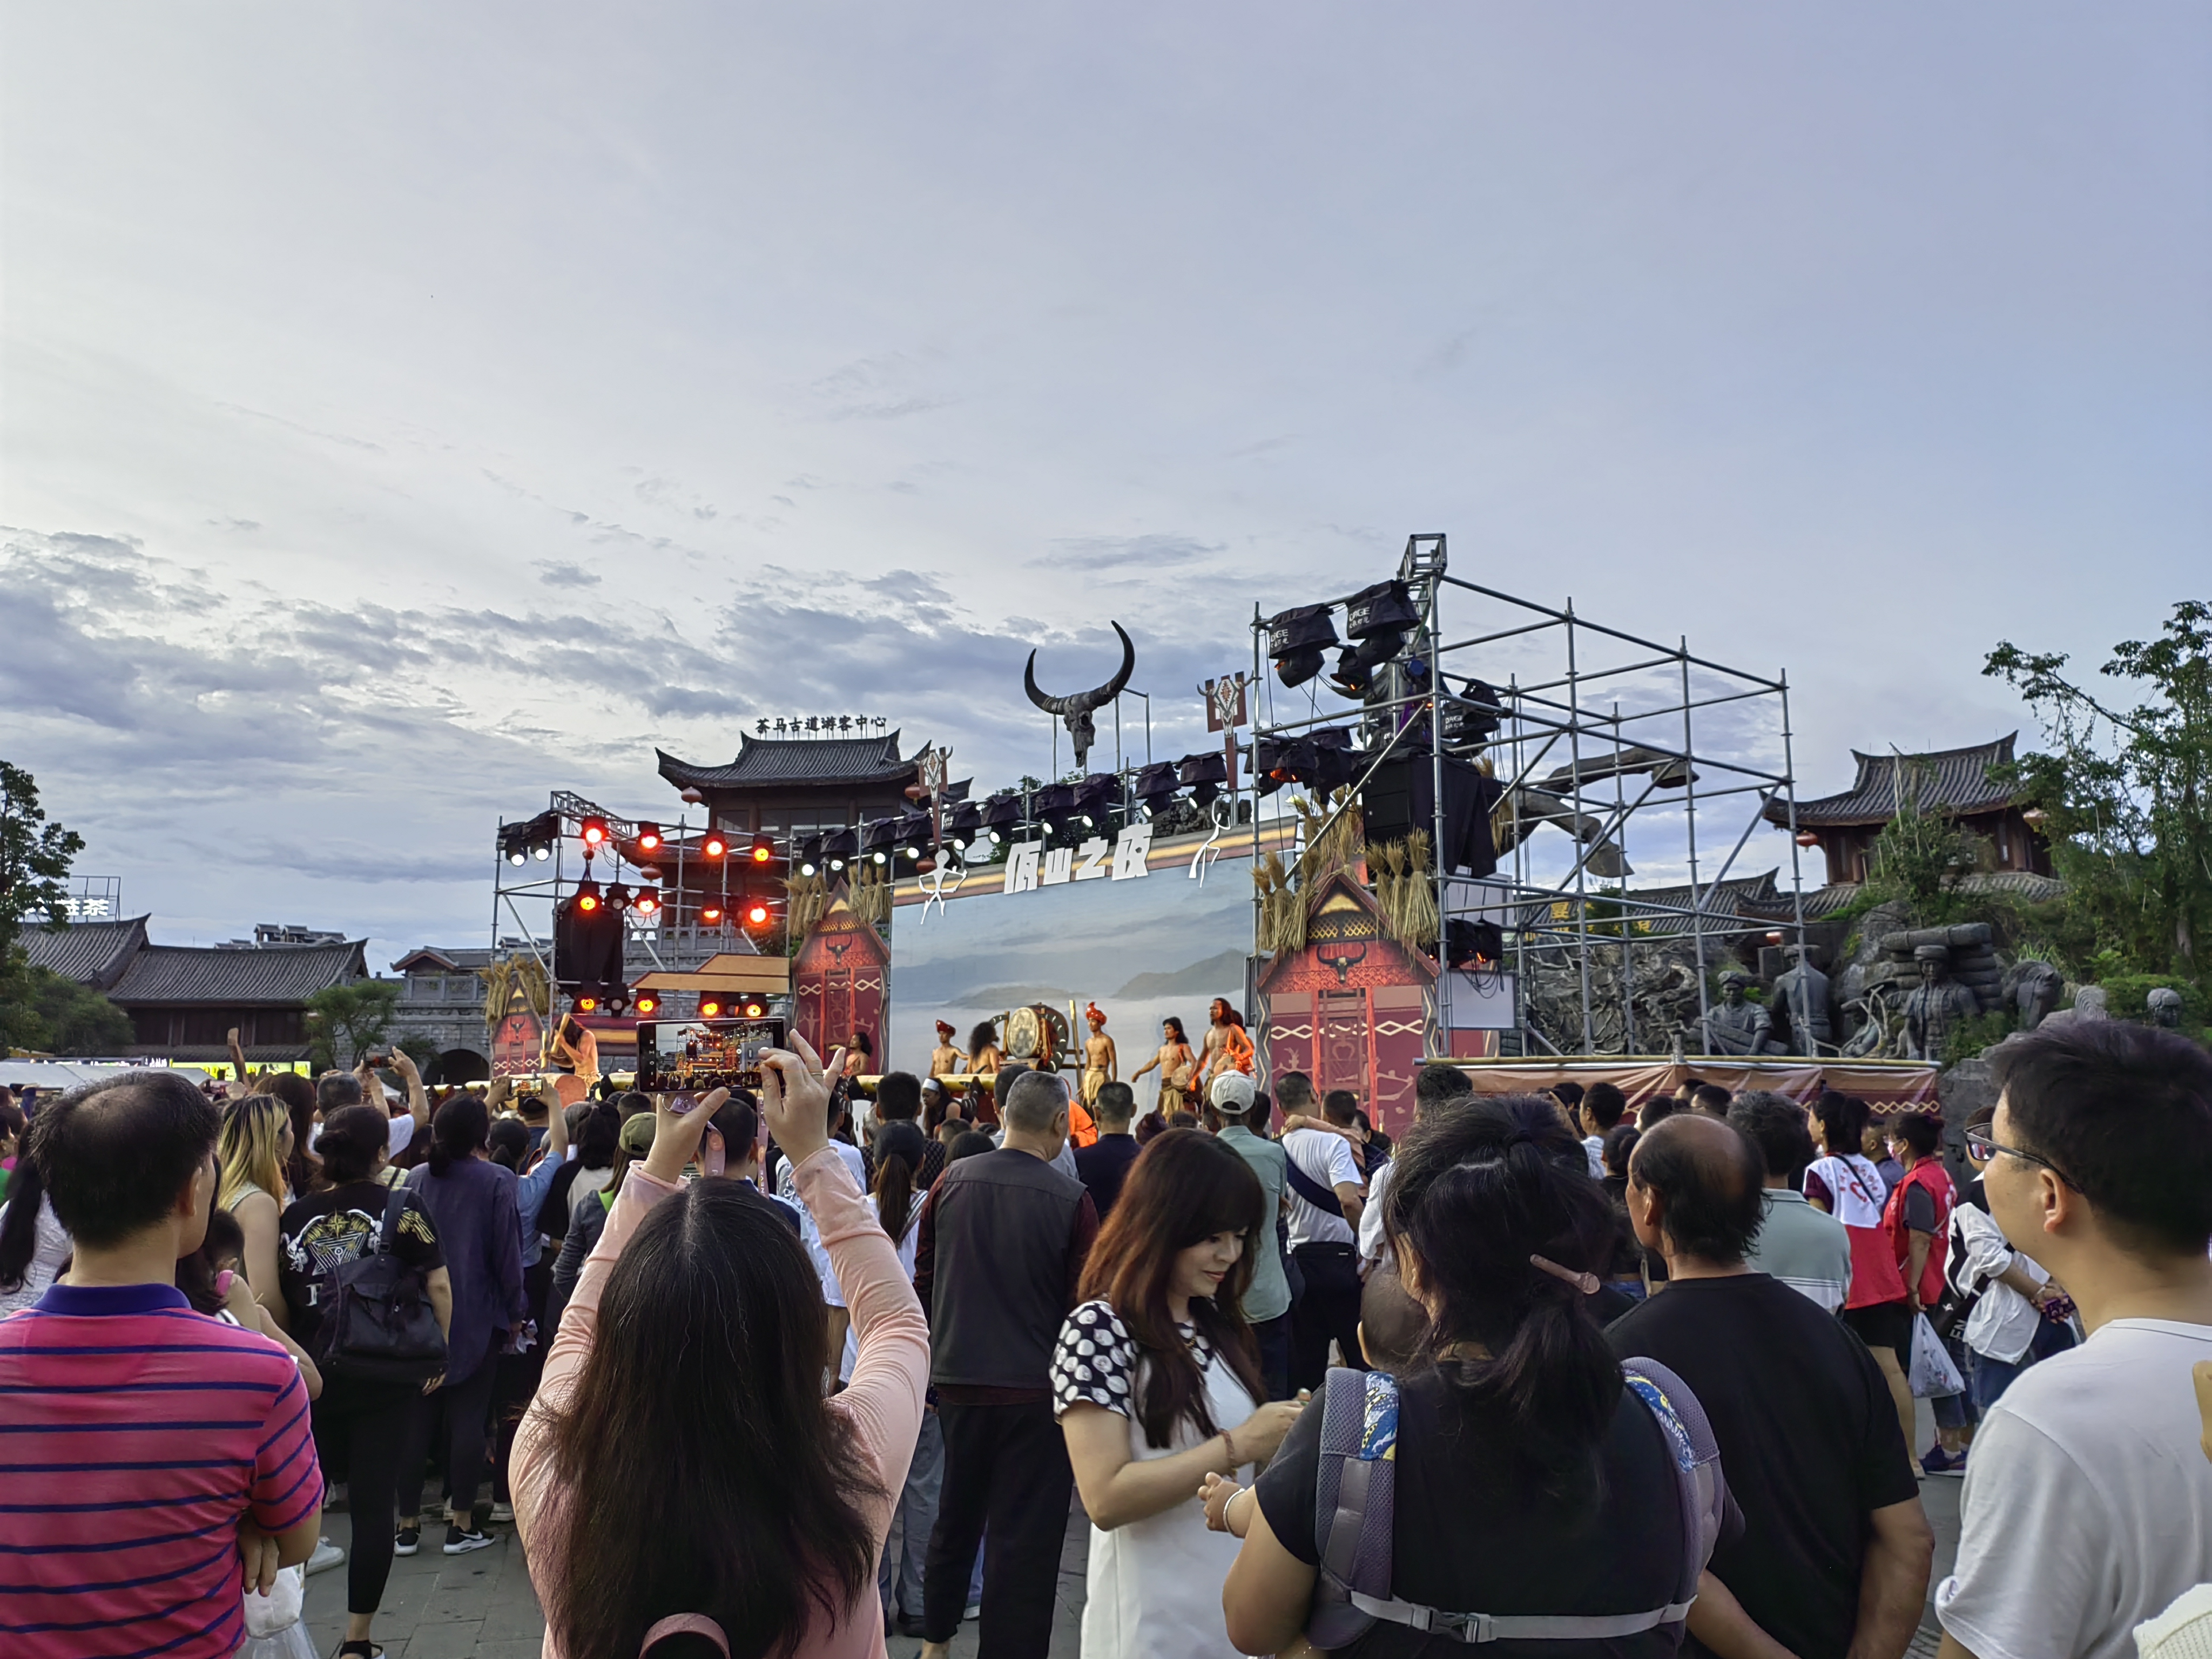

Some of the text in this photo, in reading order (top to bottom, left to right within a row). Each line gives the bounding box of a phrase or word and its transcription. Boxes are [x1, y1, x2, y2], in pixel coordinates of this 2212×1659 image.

[1271, 629, 1289, 642] DGE
[755, 714, 887, 733] 茶马古道游客中心
